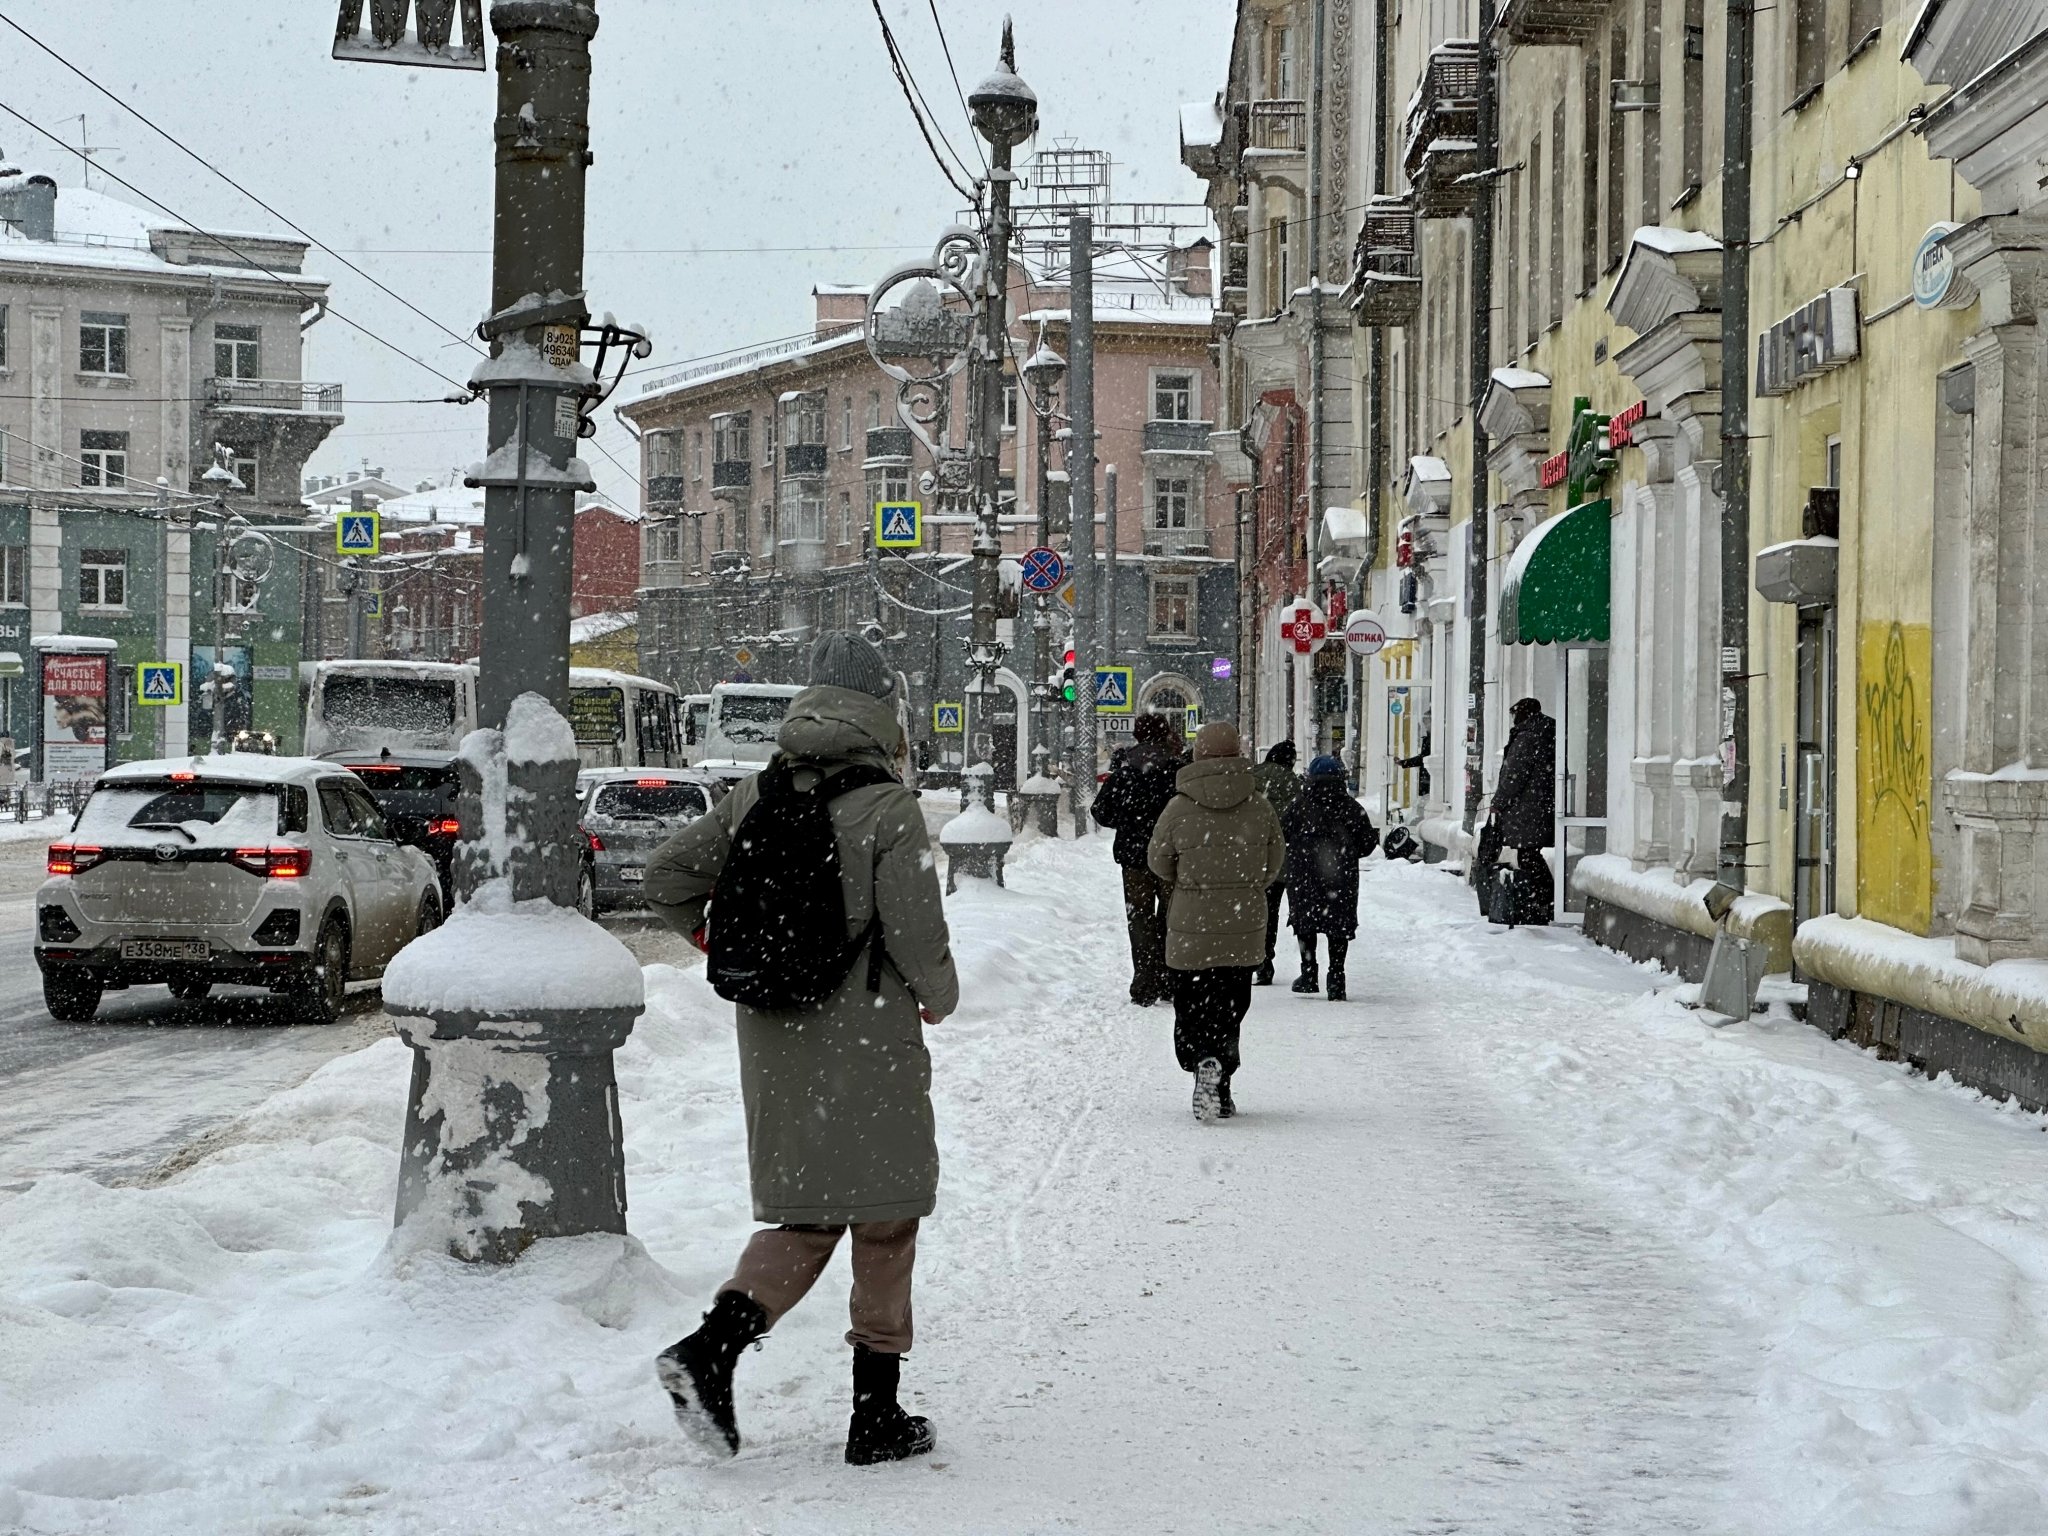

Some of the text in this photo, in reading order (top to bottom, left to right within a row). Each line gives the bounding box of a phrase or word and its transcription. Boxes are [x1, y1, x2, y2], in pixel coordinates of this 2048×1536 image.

[543, 344, 575, 357] 496340
[1297, 624, 1309, 633] 24
[1348, 633, 1382, 643] ОПТИКА
[54, 668, 96, 679] СЧАСТЬЕ
[47, 680, 103, 691] ДЛЯ ВОЛОС
[1096, 718, 1129, 730] ТОП
